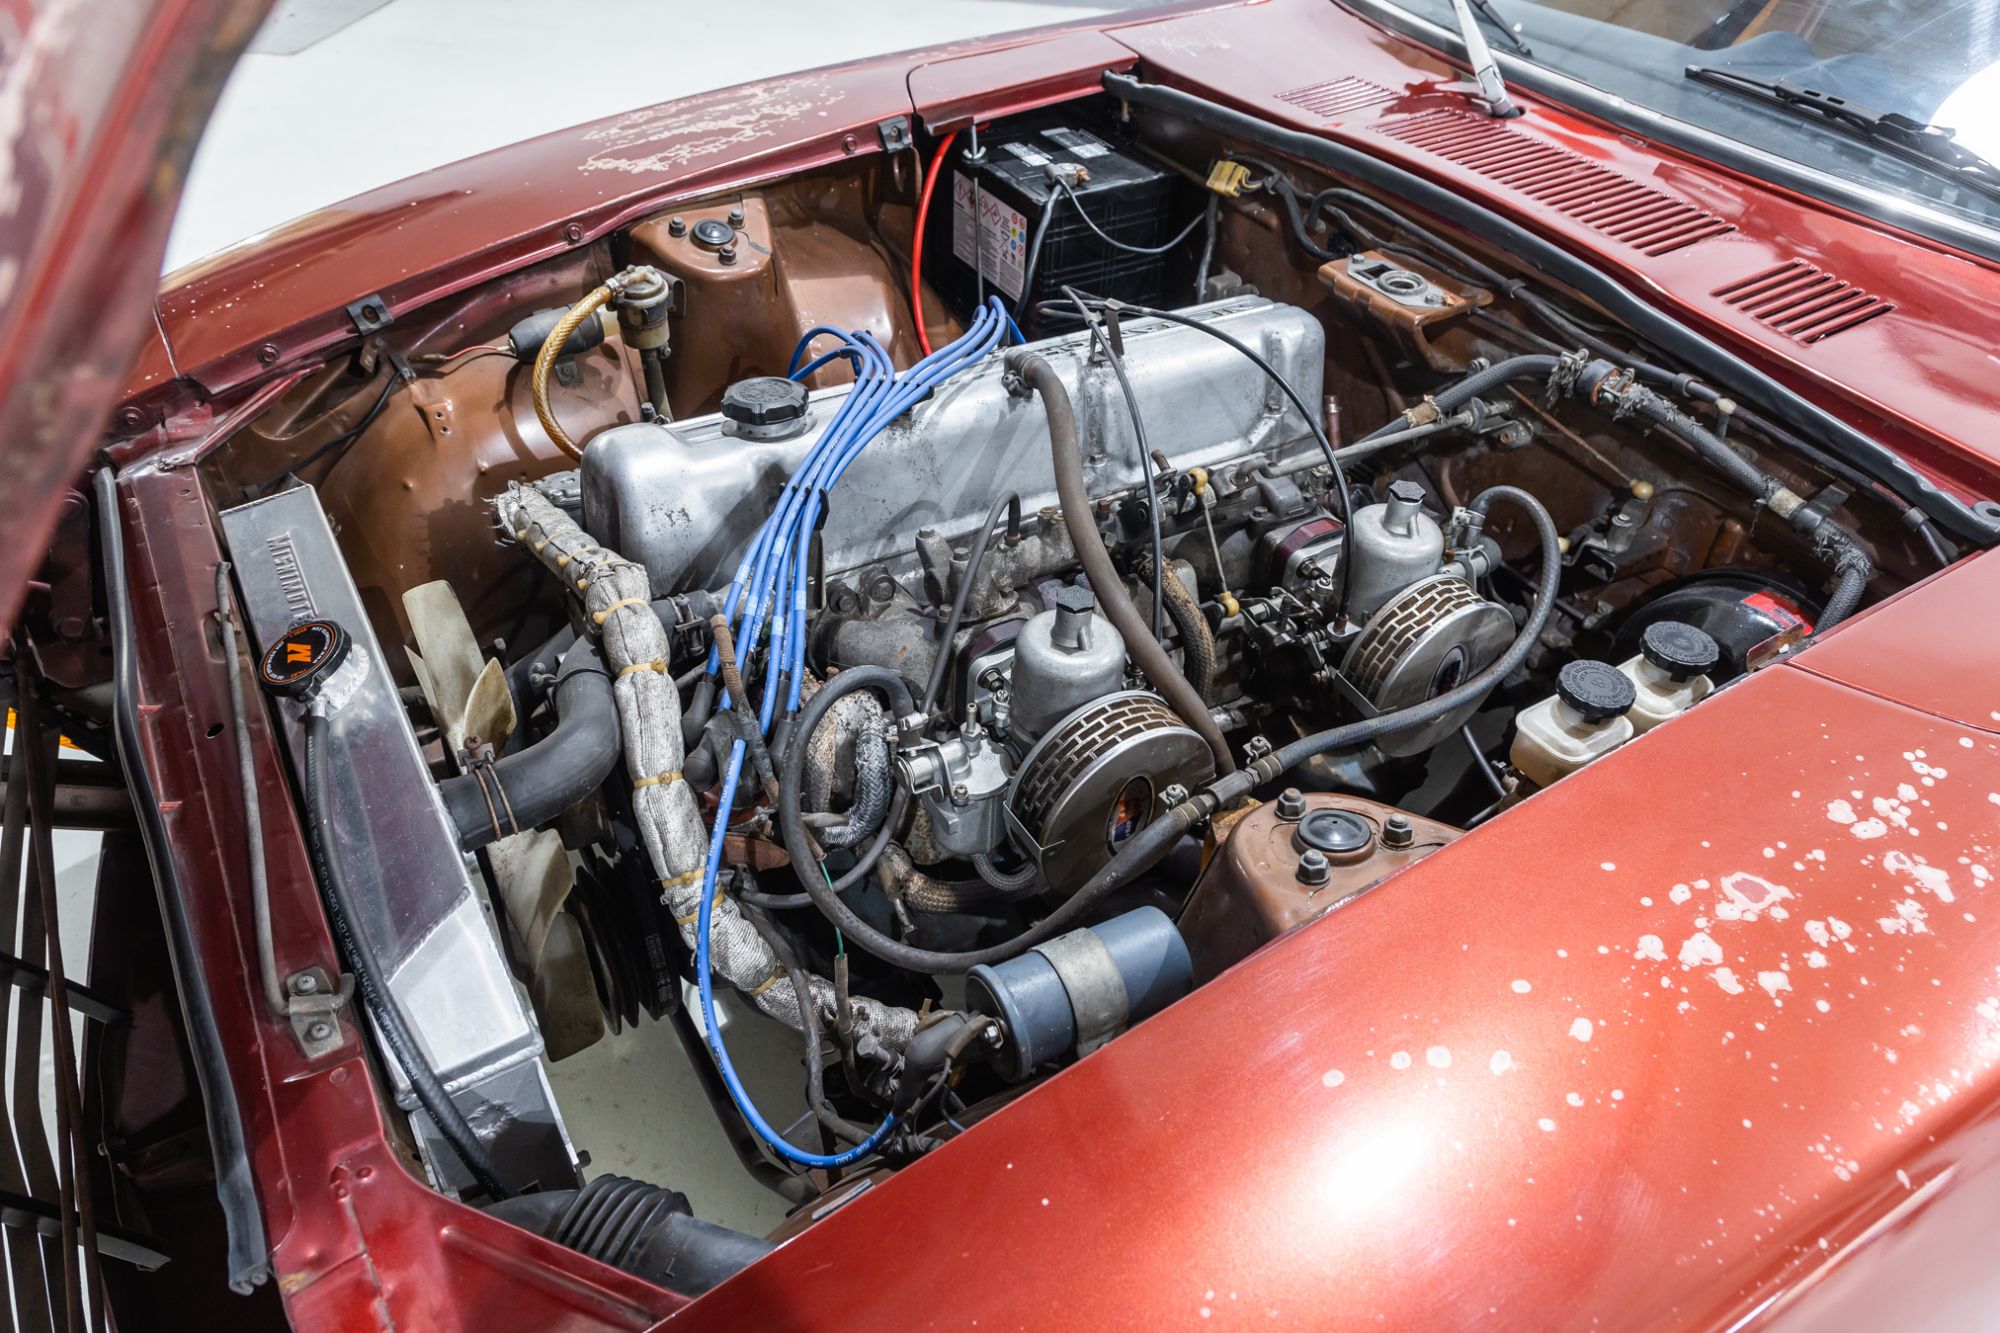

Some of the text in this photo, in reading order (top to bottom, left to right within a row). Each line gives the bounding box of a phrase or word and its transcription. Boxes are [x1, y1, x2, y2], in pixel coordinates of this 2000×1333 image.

[287, 642, 312, 664] M
[377, 1007, 394, 1031] USA
[401, 1051, 421, 1080] MADE
